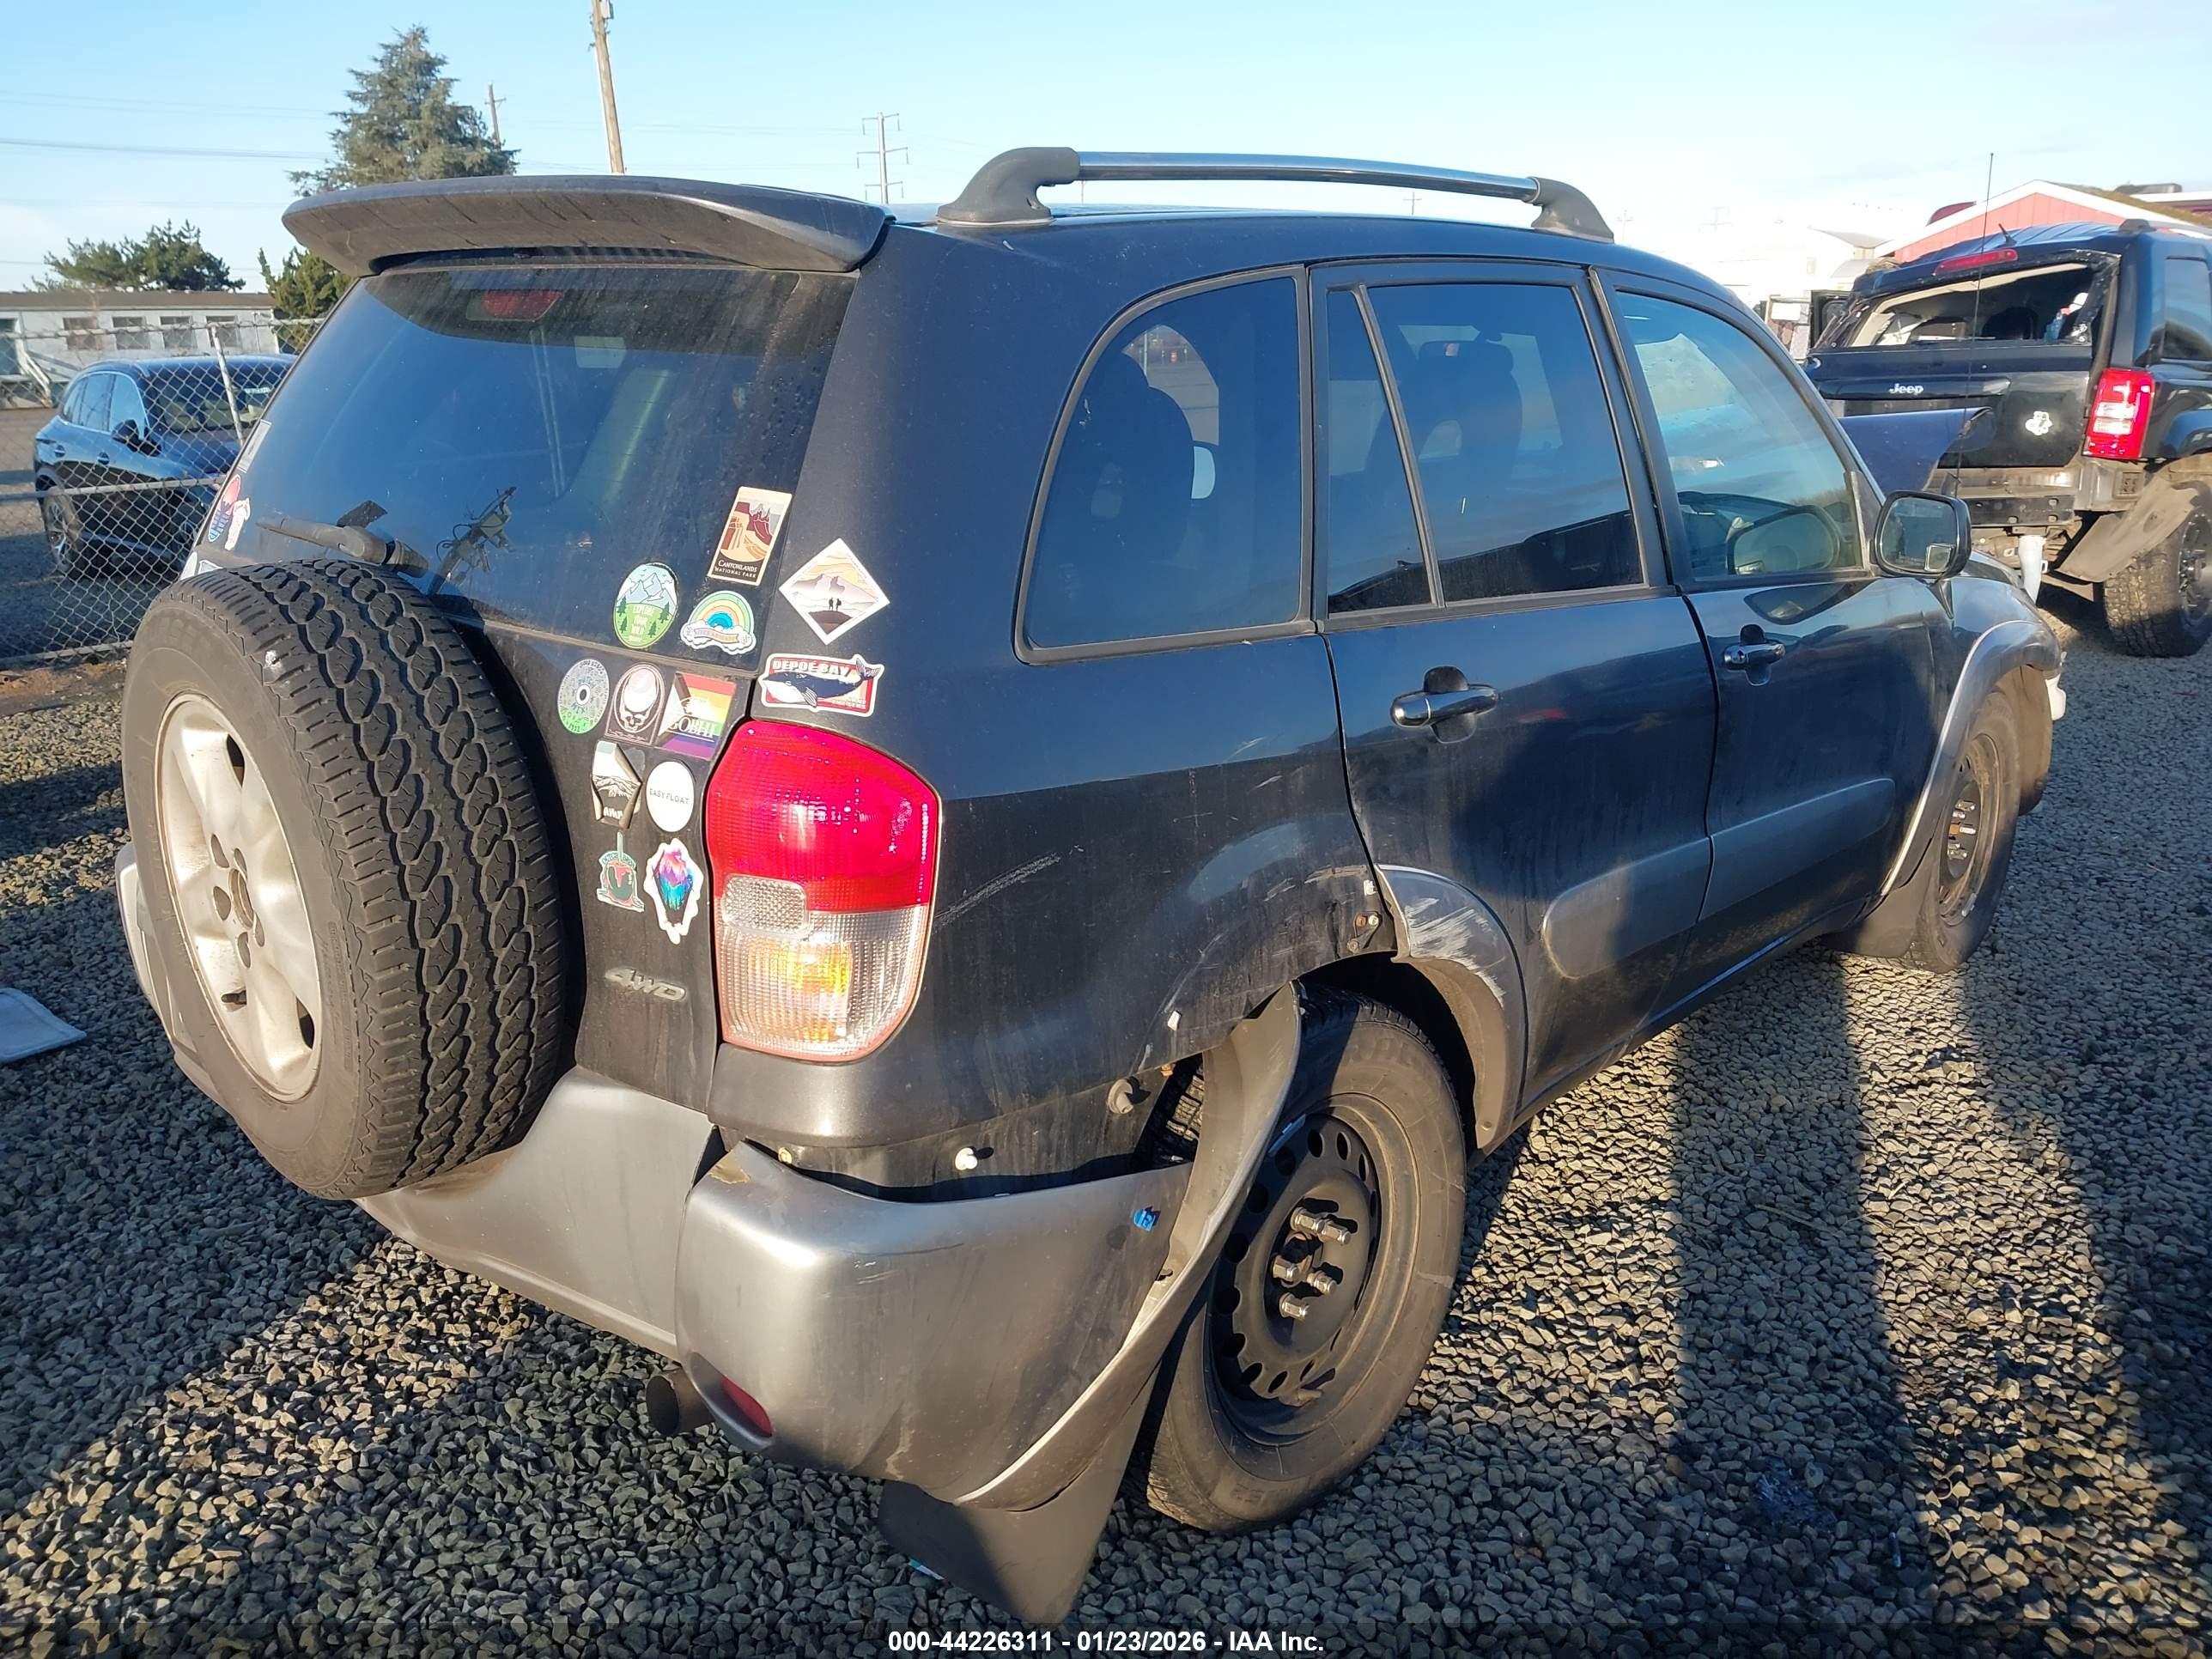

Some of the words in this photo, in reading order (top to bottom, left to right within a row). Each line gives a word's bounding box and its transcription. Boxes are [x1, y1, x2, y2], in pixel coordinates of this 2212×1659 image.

[1889, 383, 1924, 396] Jeep
[714, 567, 741, 576] NATIONAL
[773, 660, 817, 672] DEPOE
[821, 663, 851, 678] BAY
[605, 967, 686, 1001] 4WD
